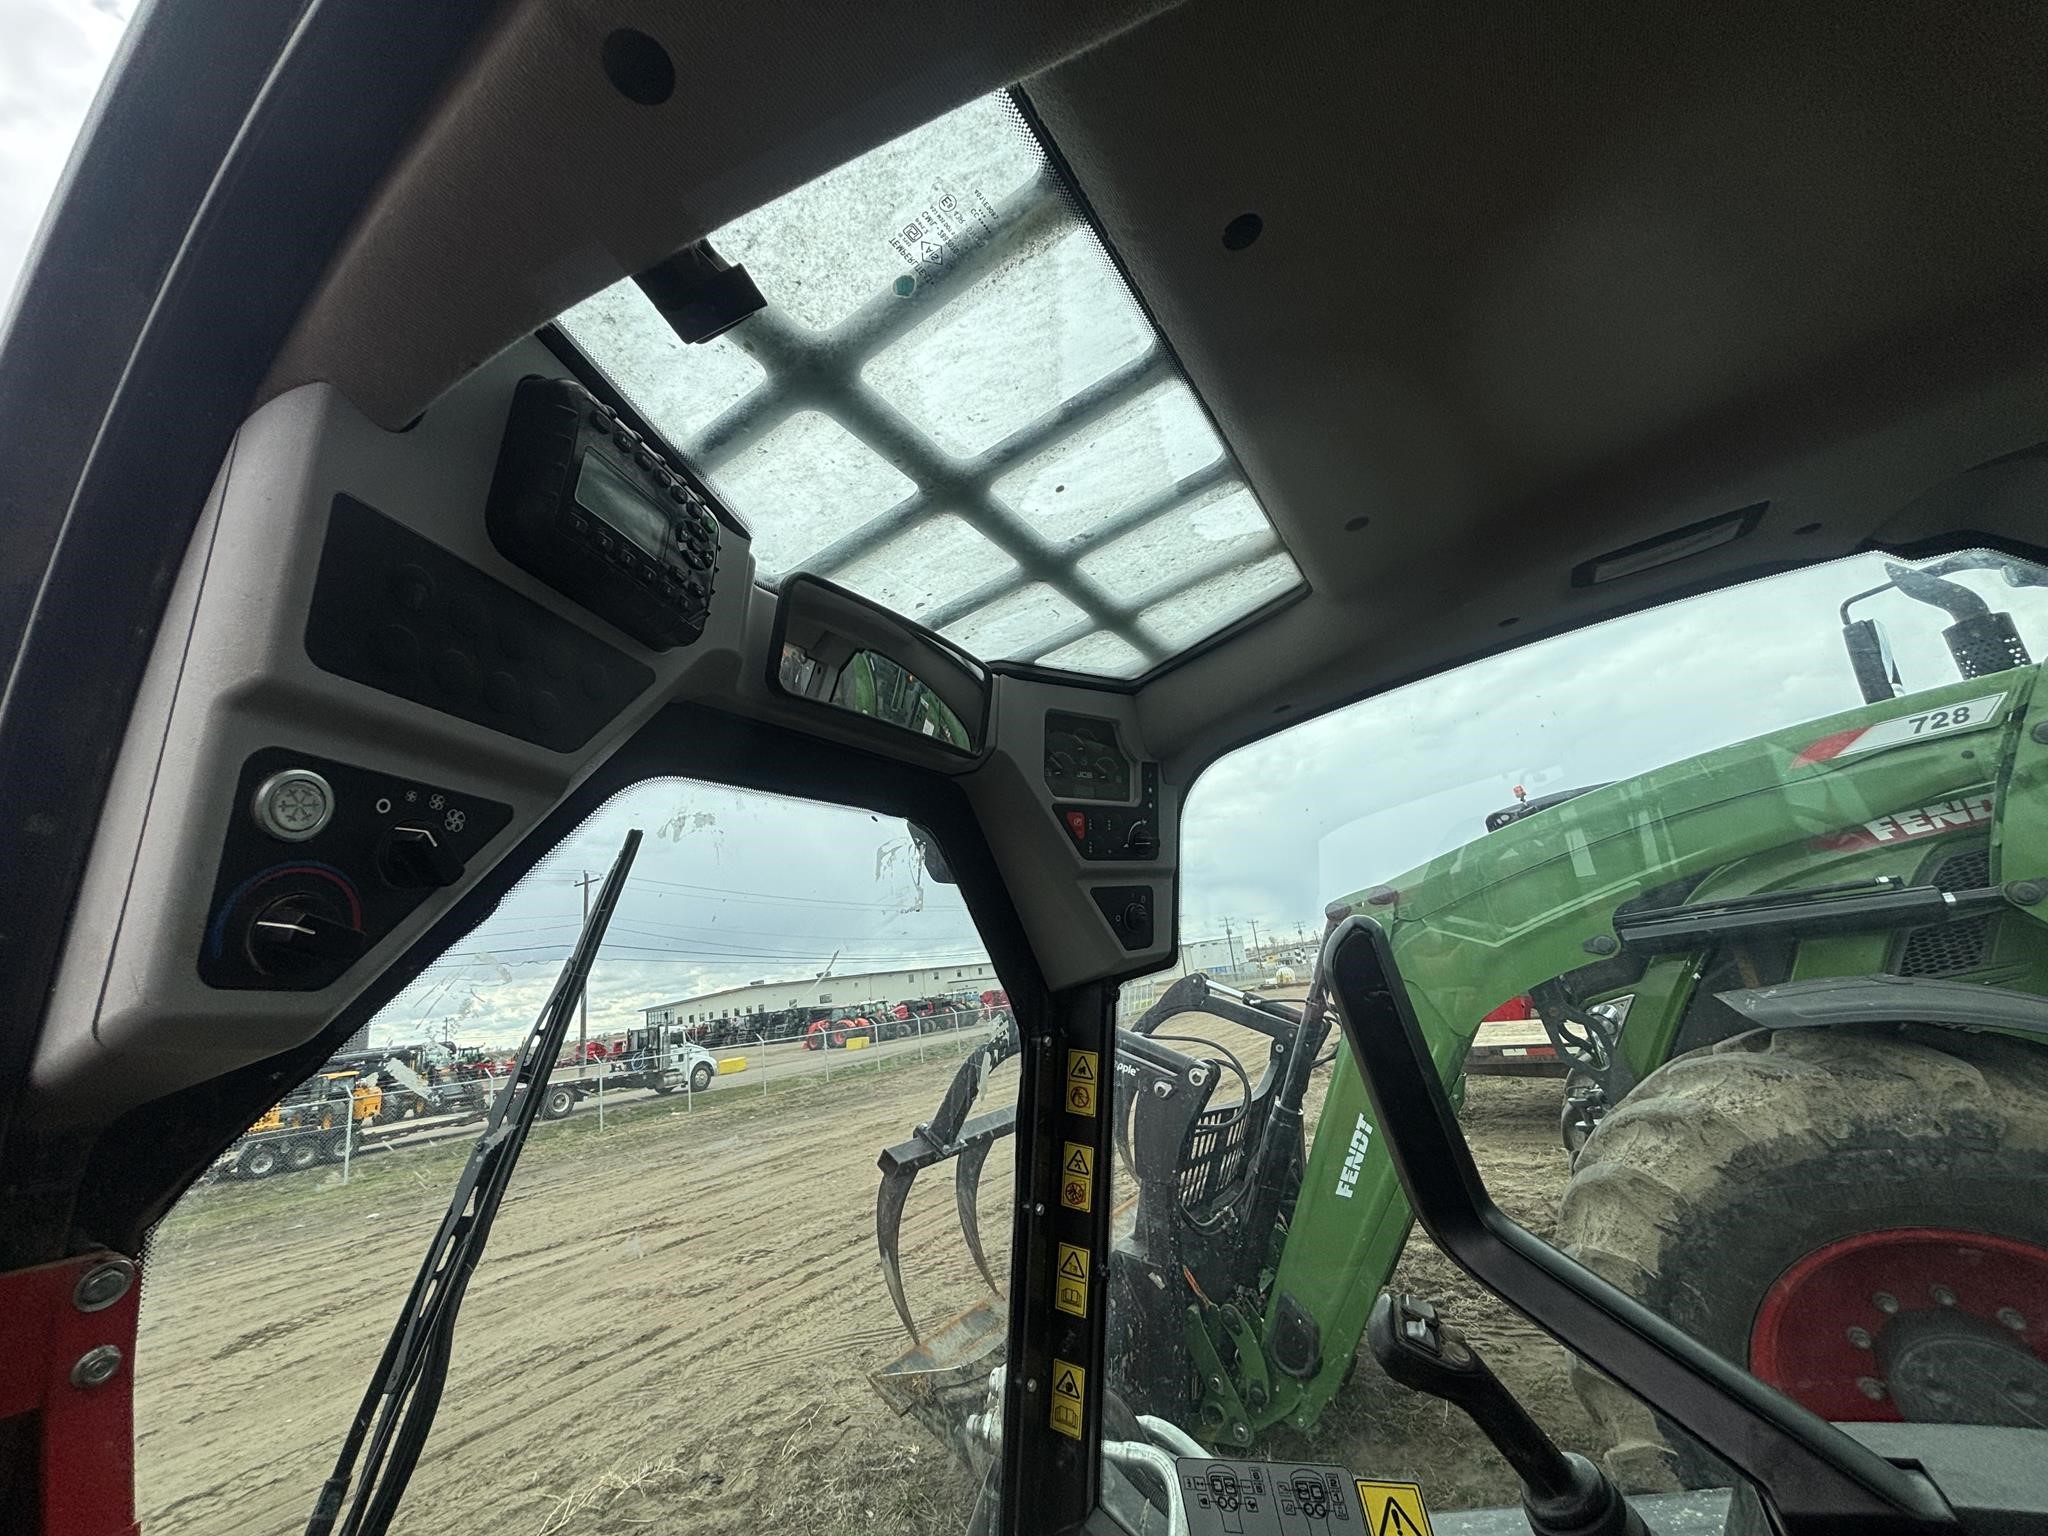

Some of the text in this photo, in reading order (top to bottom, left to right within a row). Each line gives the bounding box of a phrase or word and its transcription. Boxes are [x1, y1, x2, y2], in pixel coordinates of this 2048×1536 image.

[1909, 706, 1970, 734] 728
[1864, 795, 1993, 841] FEND
[1335, 1113, 1374, 1198] FENDT
